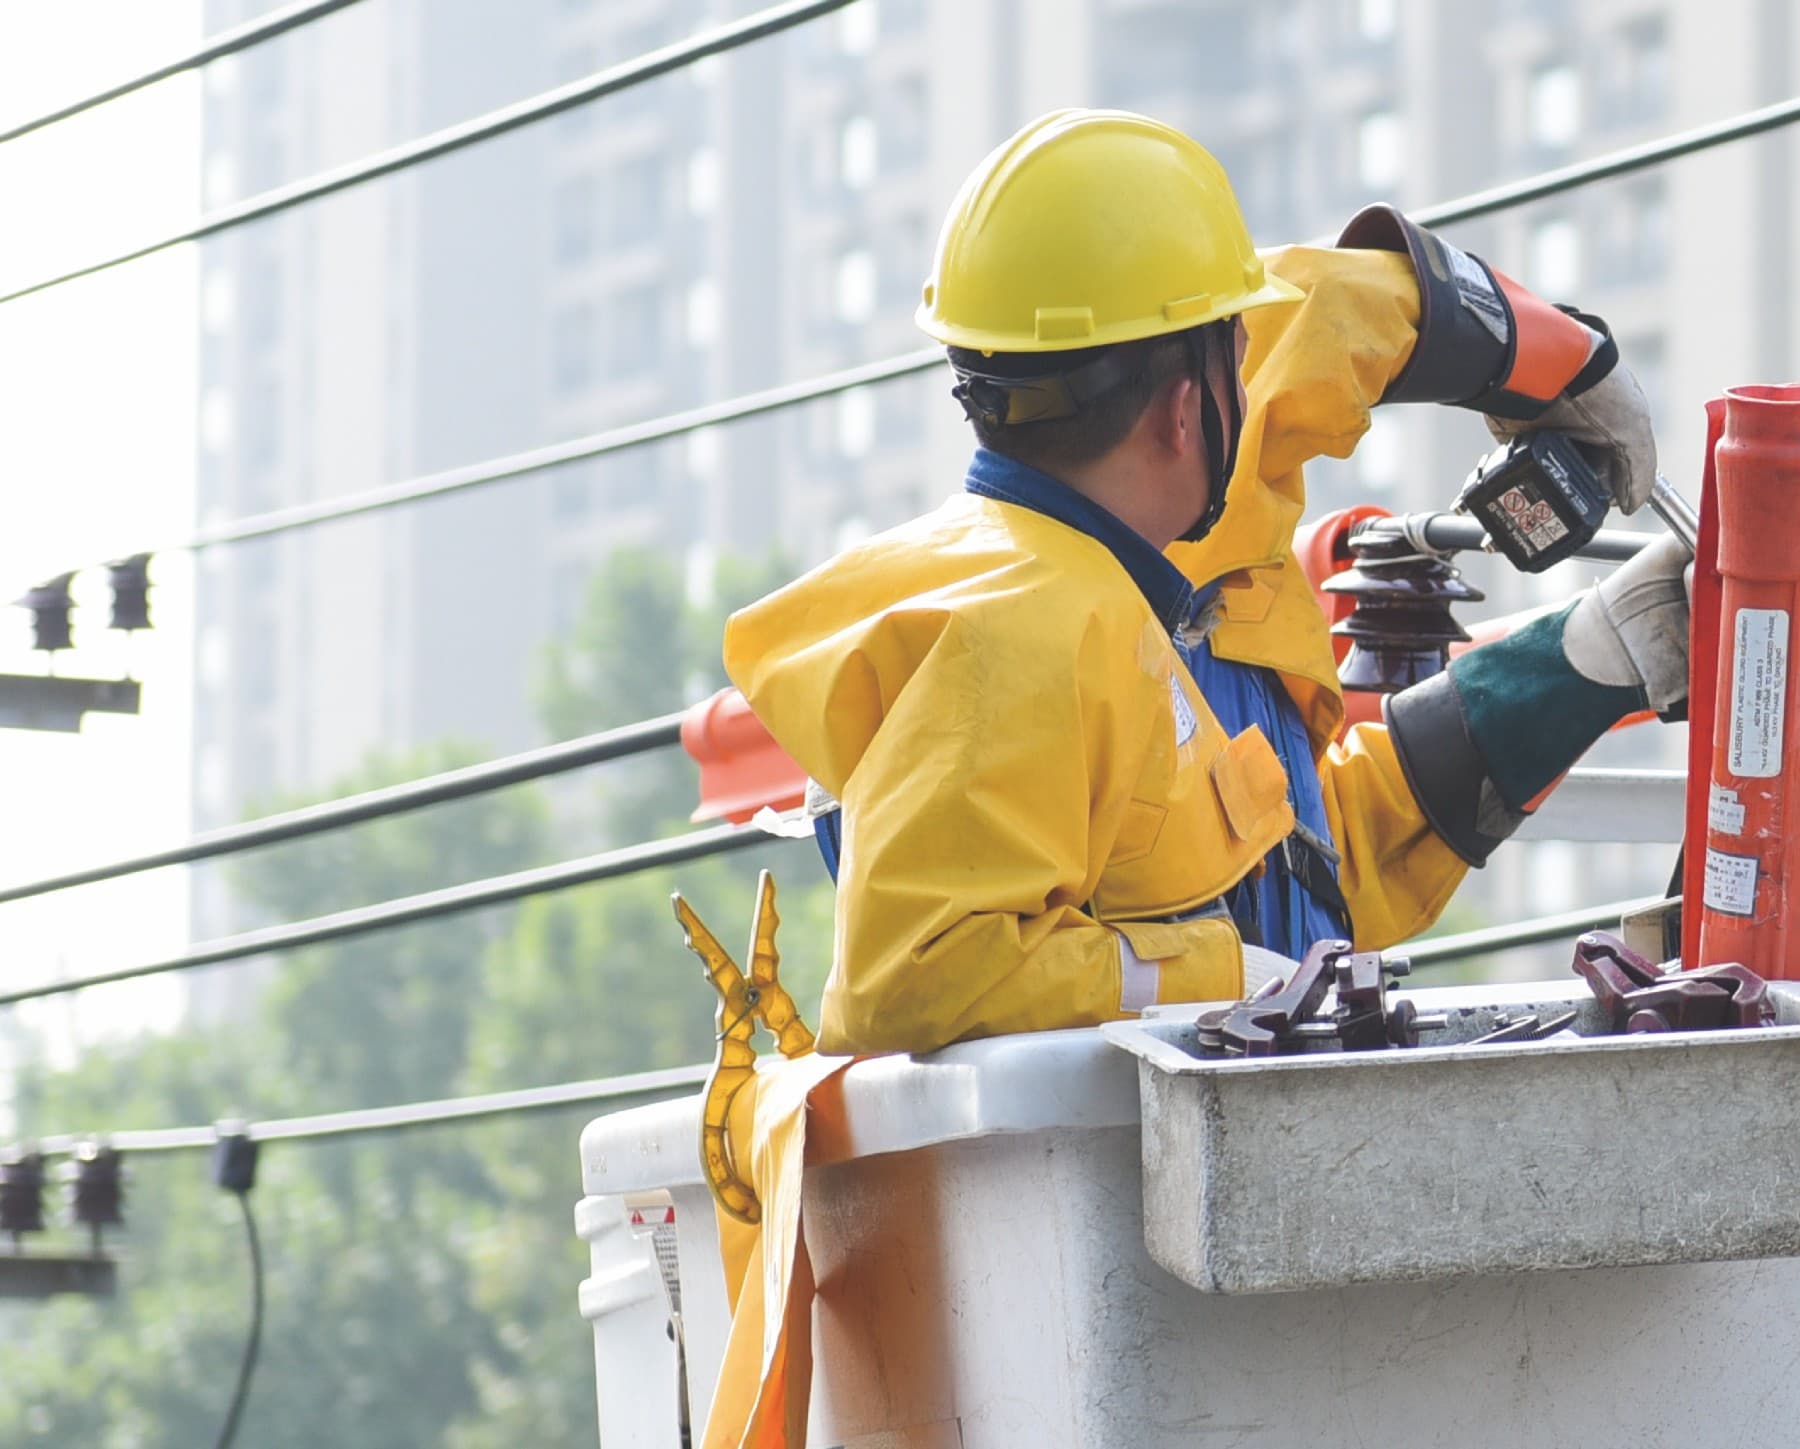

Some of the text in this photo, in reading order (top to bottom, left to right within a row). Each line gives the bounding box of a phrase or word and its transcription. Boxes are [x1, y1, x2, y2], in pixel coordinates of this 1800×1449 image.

[1766, 640, 1774, 674] GUARDED
[1765, 676, 1772, 685] TO
[1737, 685, 1745, 713] PLASTIC
[1733, 715, 1744, 768] SALISBURY
[1762, 713, 1770, 747] GUARDED
